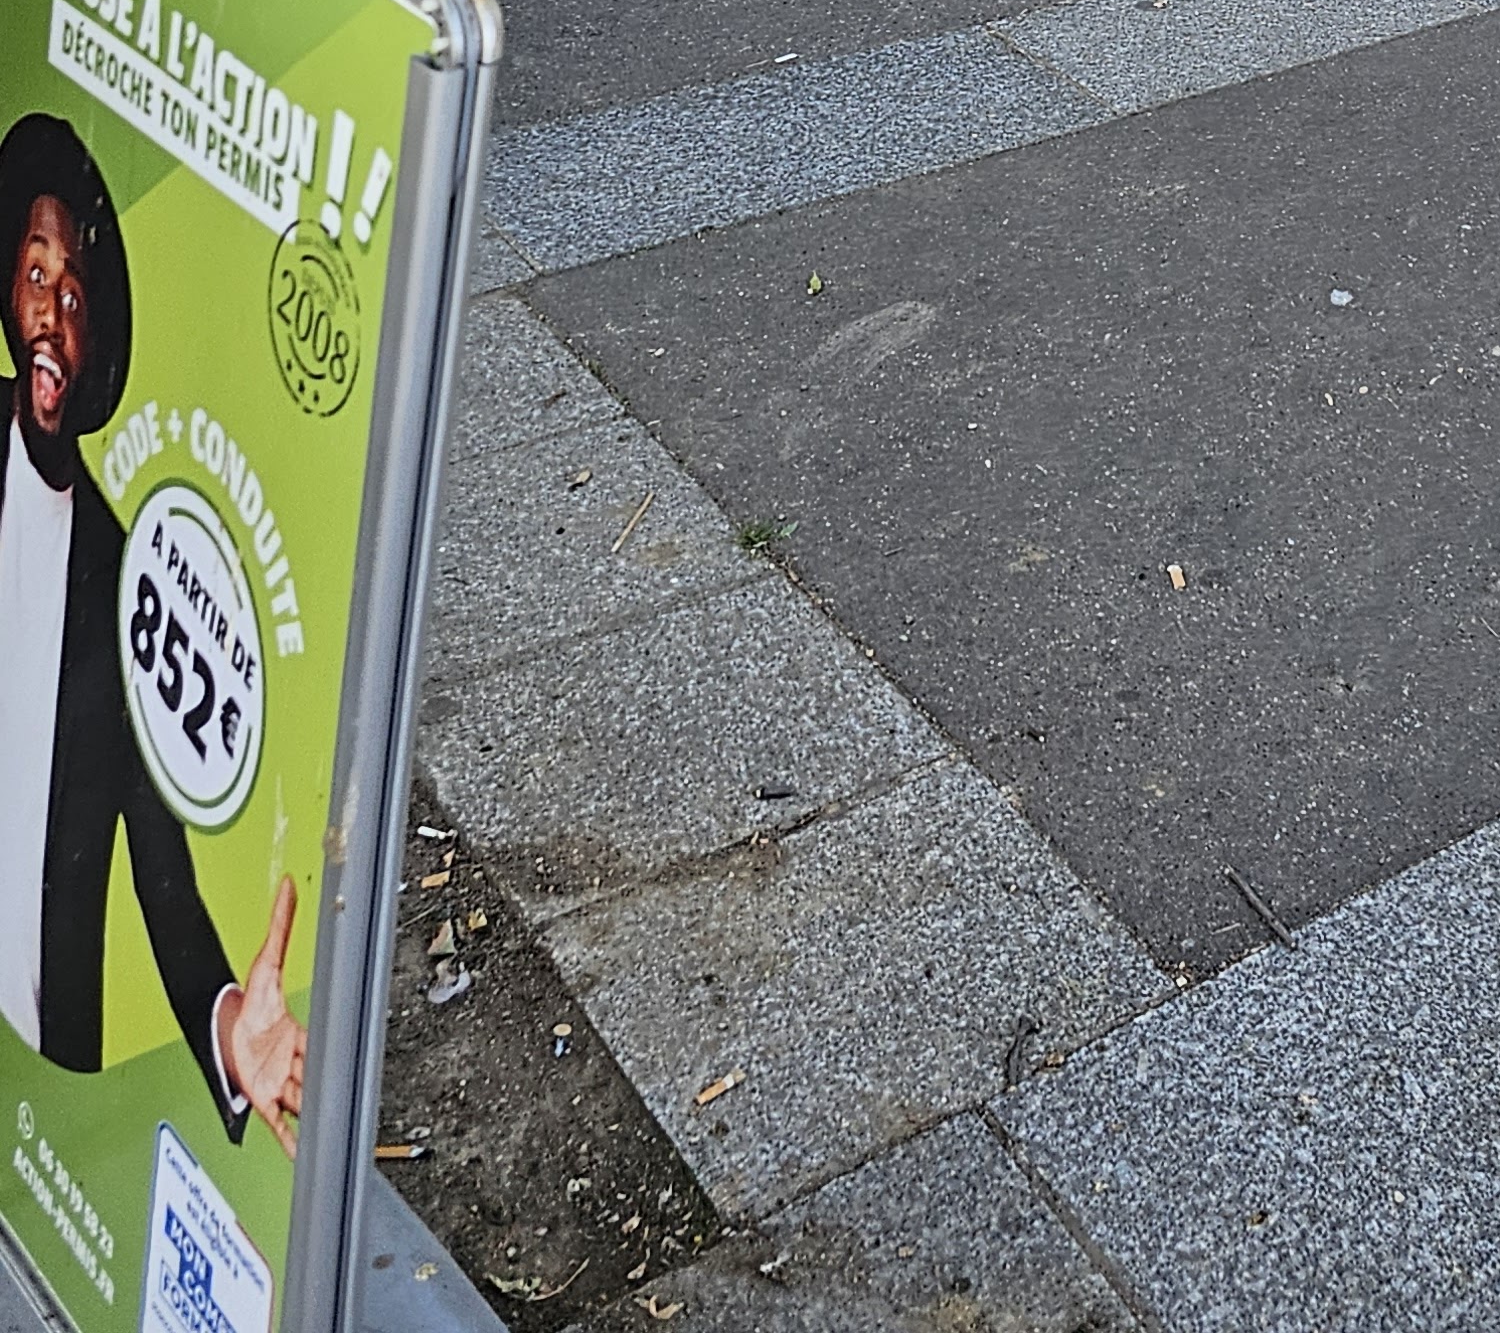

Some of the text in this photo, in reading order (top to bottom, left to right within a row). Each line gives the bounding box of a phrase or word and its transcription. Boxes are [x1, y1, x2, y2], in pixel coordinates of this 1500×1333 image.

[61, 14, 286, 215] DÉCROCHE TON PERMIS
[166, 8, 320, 188] L'ACTION
[274, 266, 354, 388] 2008
[103, 399, 164, 502] CODE
[190, 407, 305, 658] CONDUITE
[166, 538, 229, 654] PARTIR
[230, 641, 257, 693] DE
[170, 1217, 207, 1280] MON
